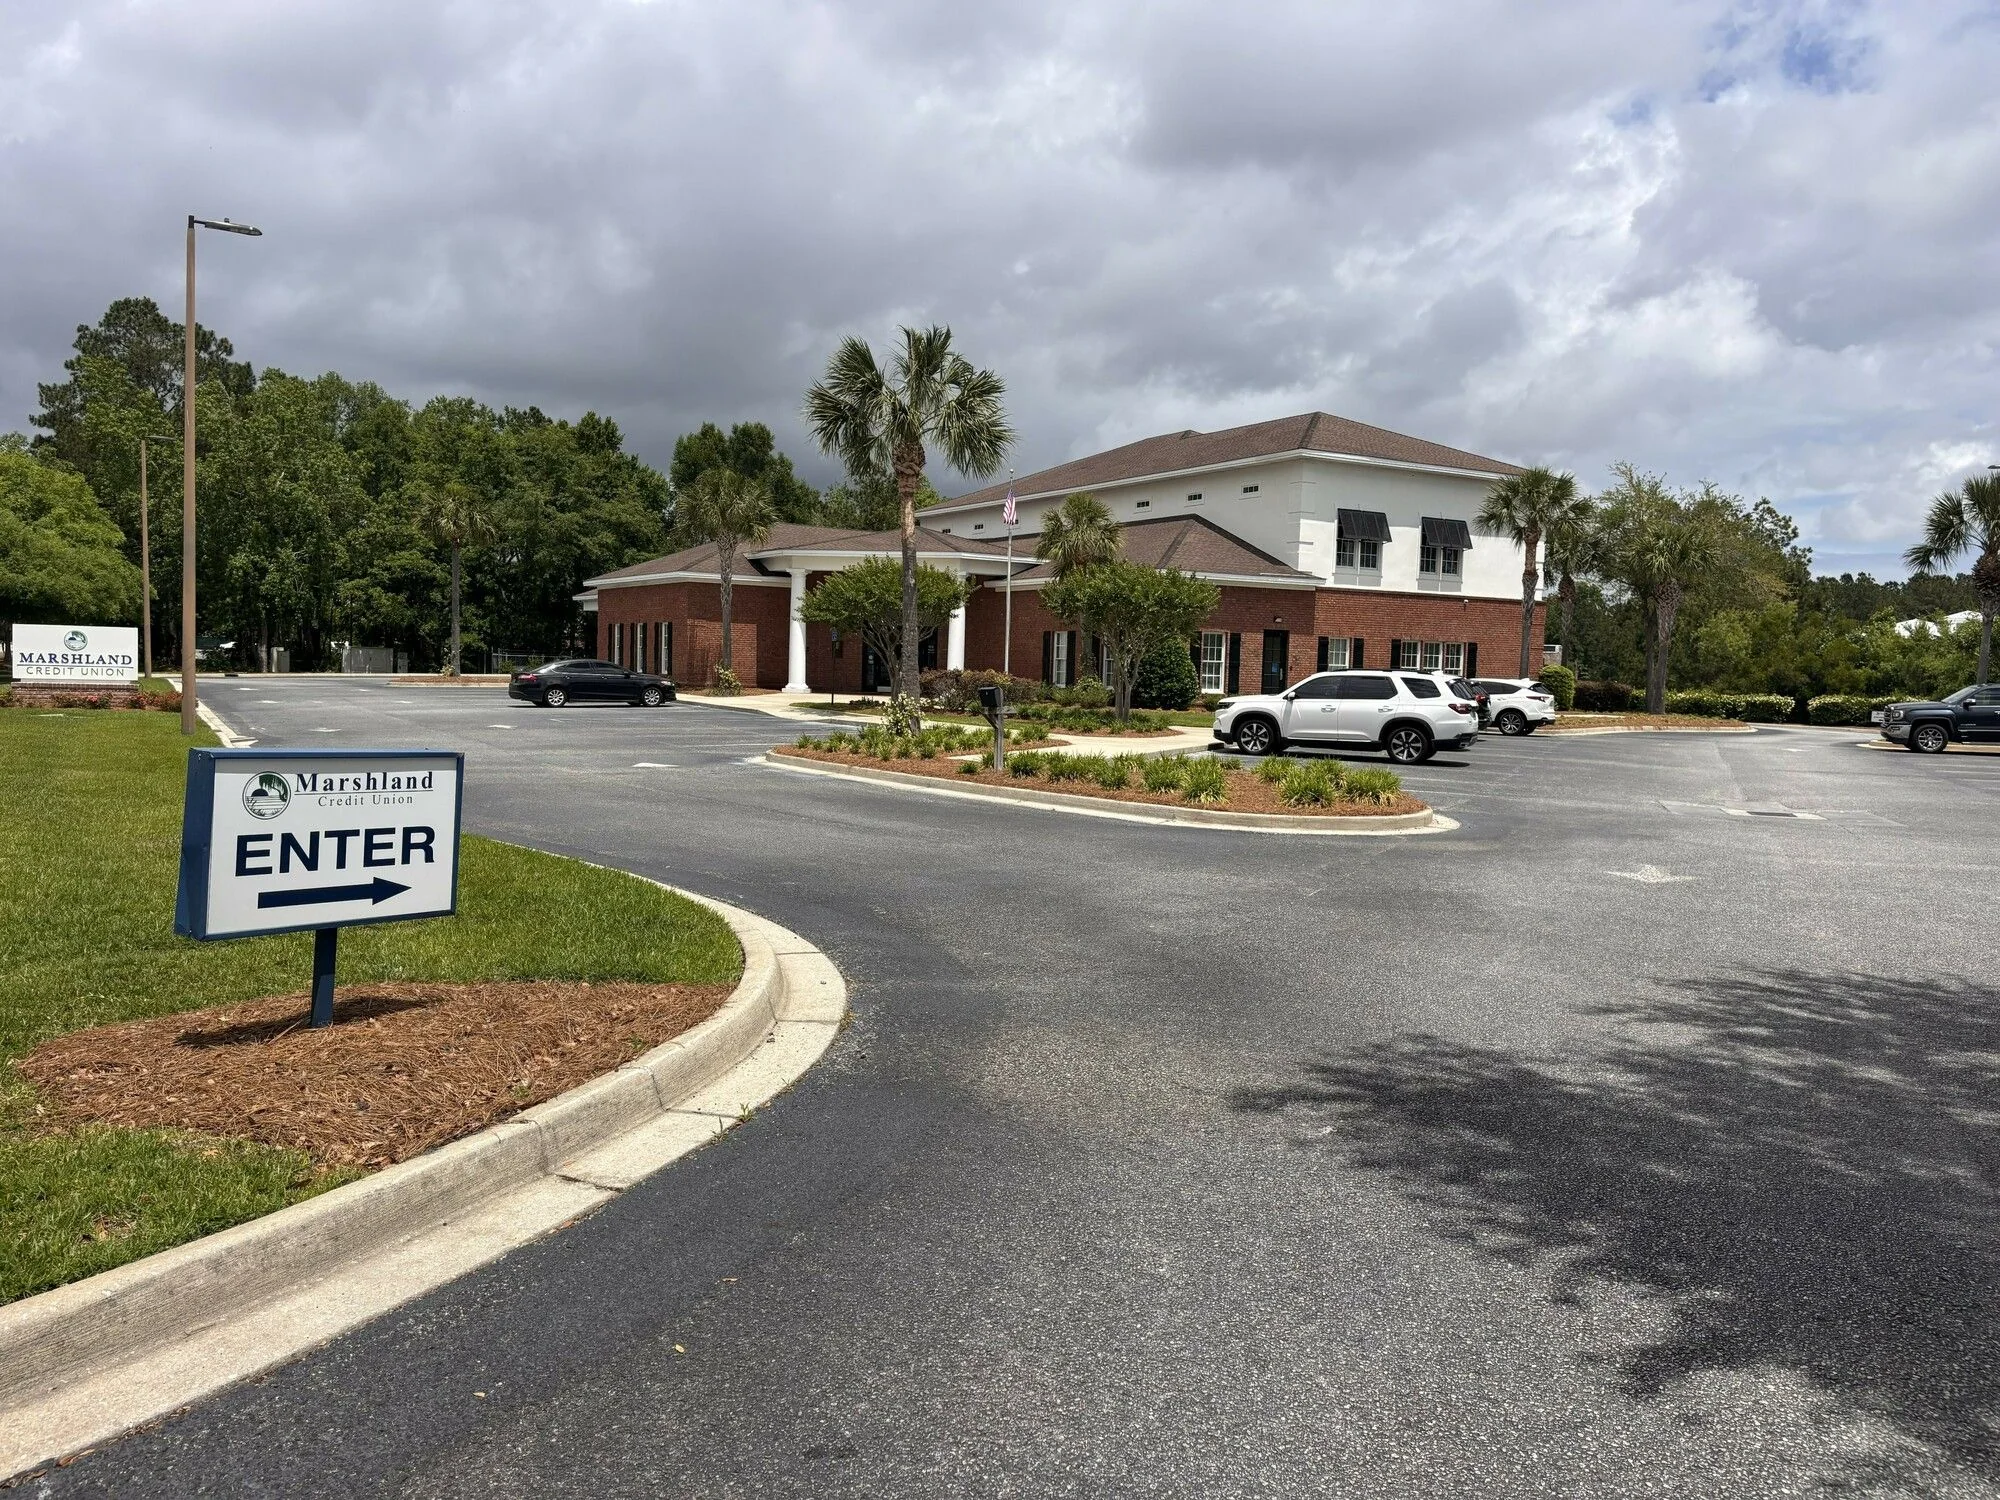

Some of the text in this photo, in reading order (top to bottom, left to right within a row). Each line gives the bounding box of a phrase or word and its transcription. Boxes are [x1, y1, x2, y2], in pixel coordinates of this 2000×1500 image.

[19, 652, 132, 665] MARSHLAND
[26, 666, 124, 676] CREDIT UNION
[294, 771, 433, 792] Marshland
[318, 794, 413, 807] Credit Union
[235, 826, 435, 876] ENTER
